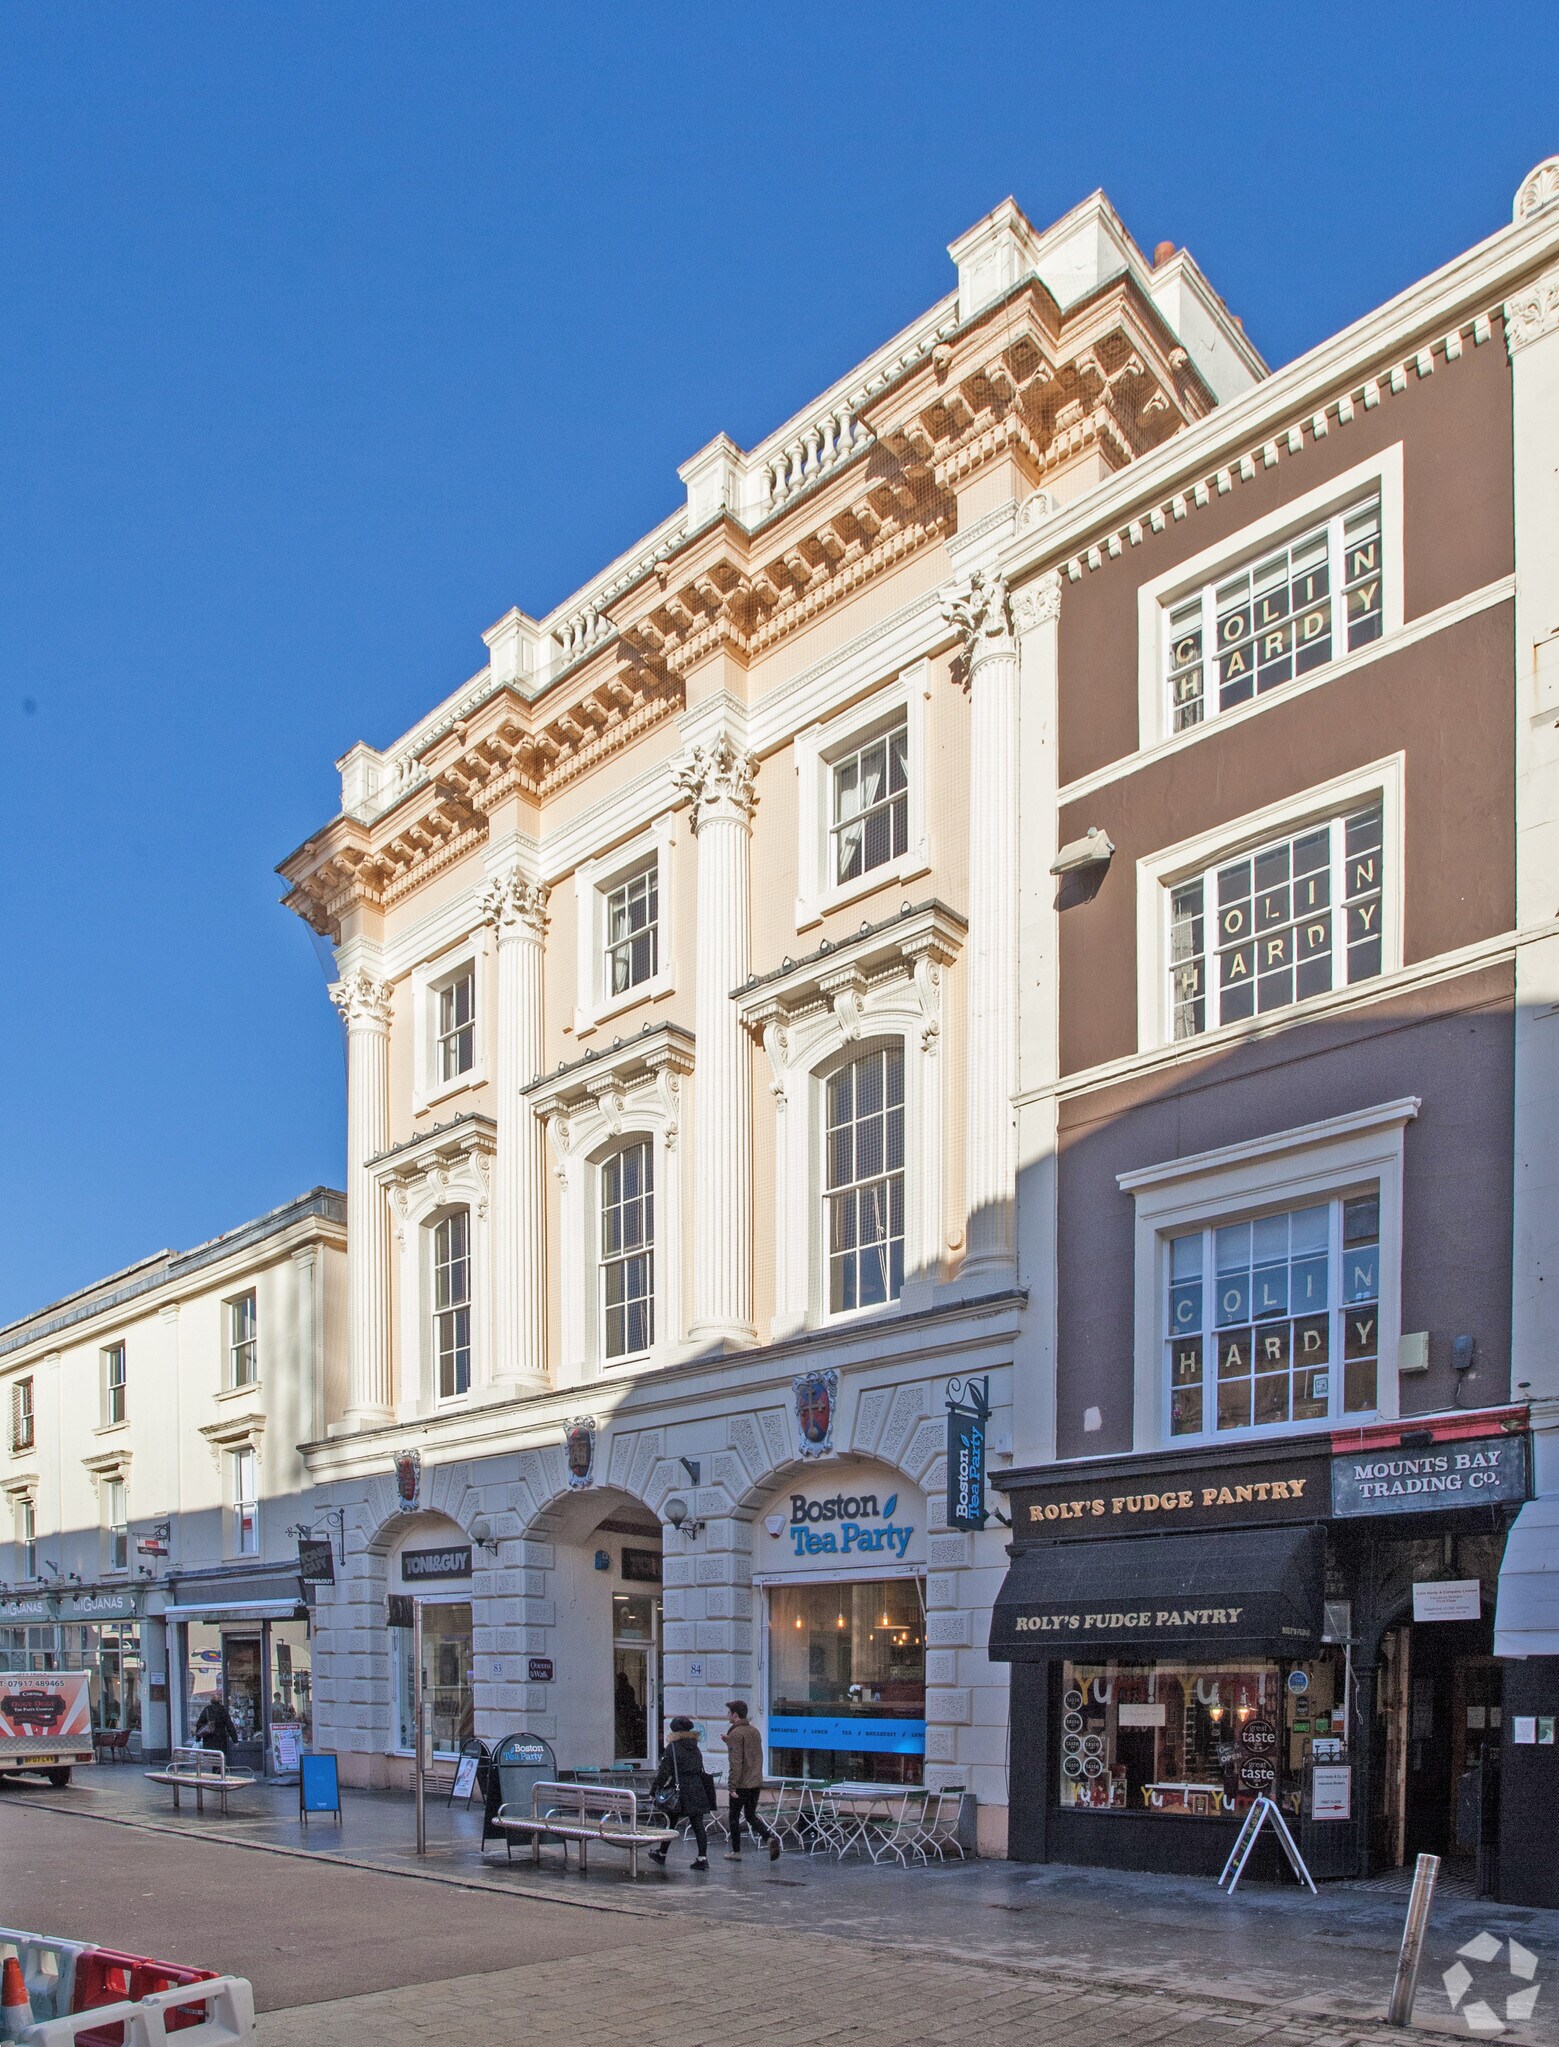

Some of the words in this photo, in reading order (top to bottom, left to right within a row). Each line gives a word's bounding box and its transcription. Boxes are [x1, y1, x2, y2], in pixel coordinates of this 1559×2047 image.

[1176, 544, 1377, 663] COLIN
[1180, 581, 1379, 701] HARDY
[1176, 1264, 1373, 1322] COLIN
[1180, 1320, 1374, 1375] HARDY
[969, 1425, 984, 1481] Party
[1354, 1456, 1448, 1480] MOUNTS
[1454, 1450, 1502, 1470] BAY
[956, 1449, 969, 1519] Boston
[1029, 1499, 1105, 1521] ROLY'S
[1111, 1490, 1194, 1514] FUDGE
[1201, 1479, 1307, 1506] PANTRY
[1359, 1474, 1463, 1499] TRADING
[790, 1492, 880, 1524] Boston
[968, 1484, 980, 1520] Tea
[790, 1525, 838, 1556] Tea
[841, 1522, 914, 1559] Party
[406, 1552, 470, 1575] TONI&GUY
[1015, 1615, 1081, 1630] ROLY'S
[1083, 1612, 1152, 1629] FUDGE
[1155, 1608, 1243, 1626] PANTRY
[690, 1664, 702, 1674] 84
[514, 1743, 544, 1752] Boston
[1242, 1731, 1276, 1743] taste
[520, 1752, 543, 1762] Party
[1241, 1768, 1275, 1780] taste
